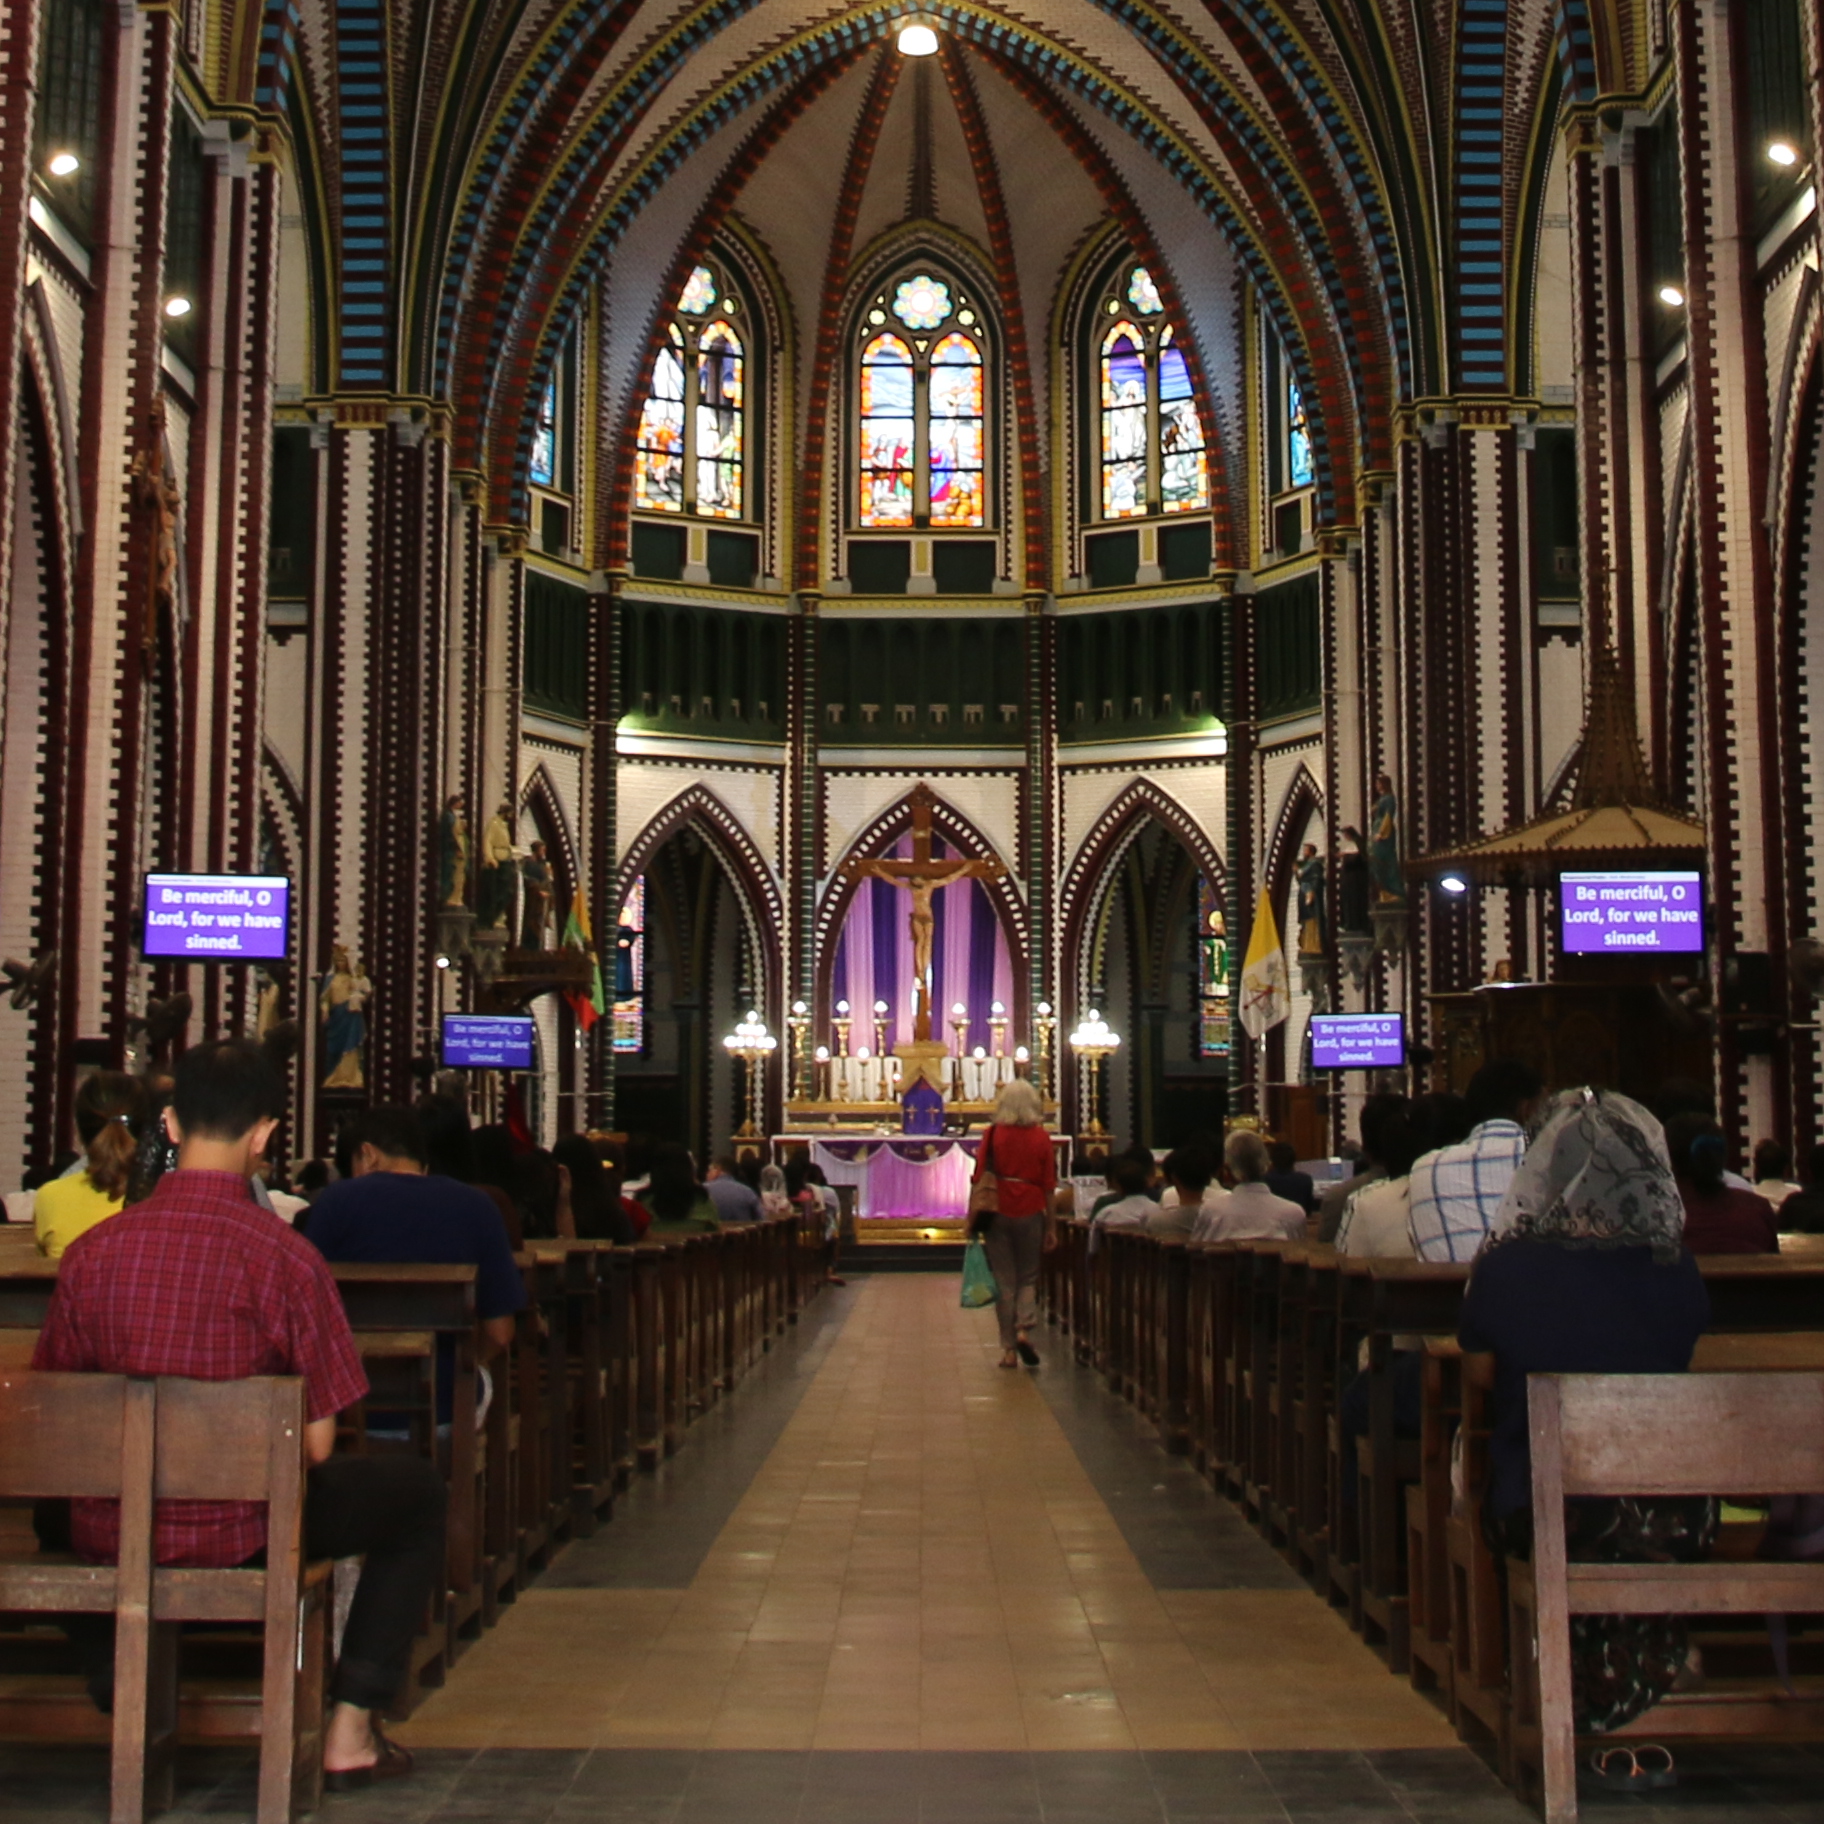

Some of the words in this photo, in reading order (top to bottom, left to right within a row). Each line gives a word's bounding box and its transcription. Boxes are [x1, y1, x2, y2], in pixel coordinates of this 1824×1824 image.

[161, 888, 182, 903] Be
[185, 889, 254, 907] merciful,
[256, 891, 271, 906] O
[1576, 886, 1596, 900] Be
[1600, 885, 1668, 902] merciful,
[1672, 885, 1685, 900] O
[148, 910, 188, 928] Lord,
[191, 910, 214, 926] for
[217, 915, 241, 927] we
[244, 912, 282, 928] have
[1564, 908, 1604, 924] Lord,
[1608, 907, 1631, 922] for
[1634, 911, 1657, 922] we
[1661, 907, 1698, 922] have
[185, 934, 242, 950] sinned.
[1604, 930, 1660, 945] sinned.
